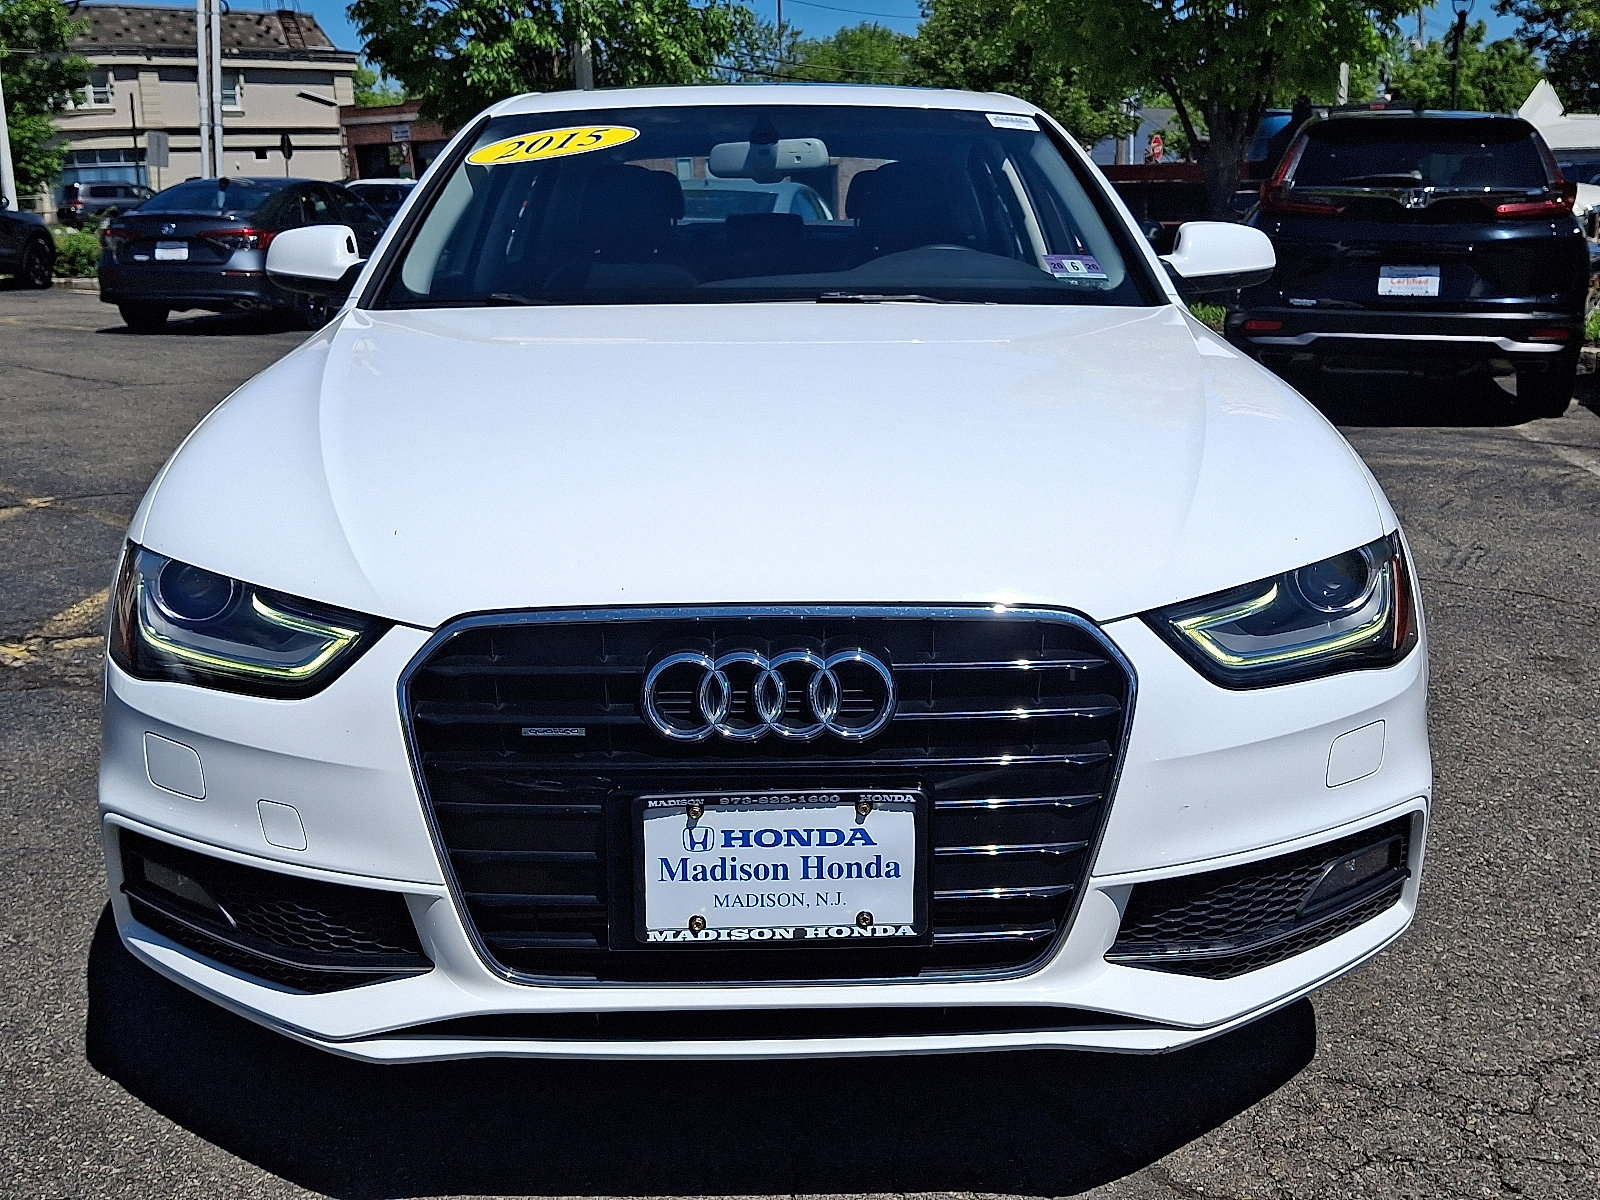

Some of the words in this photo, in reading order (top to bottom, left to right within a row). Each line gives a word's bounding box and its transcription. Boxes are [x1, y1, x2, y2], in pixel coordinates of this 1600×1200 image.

[494, 128, 610, 161] 2015
[1070, 261, 1080, 271] 6
[647, 798, 705, 808] MADISON
[719, 794, 841, 805] 973-822-1600
[859, 794, 917, 803] HONDA
[720, 827, 878, 849] HONDA
[657, 856, 791, 882] Madison
[799, 854, 901, 880] Honda
[713, 893, 811, 909] MADISON,
[816, 892, 847, 906] N.J.
[646, 929, 796, 942] MADISON
[804, 924, 917, 939] HONDA
